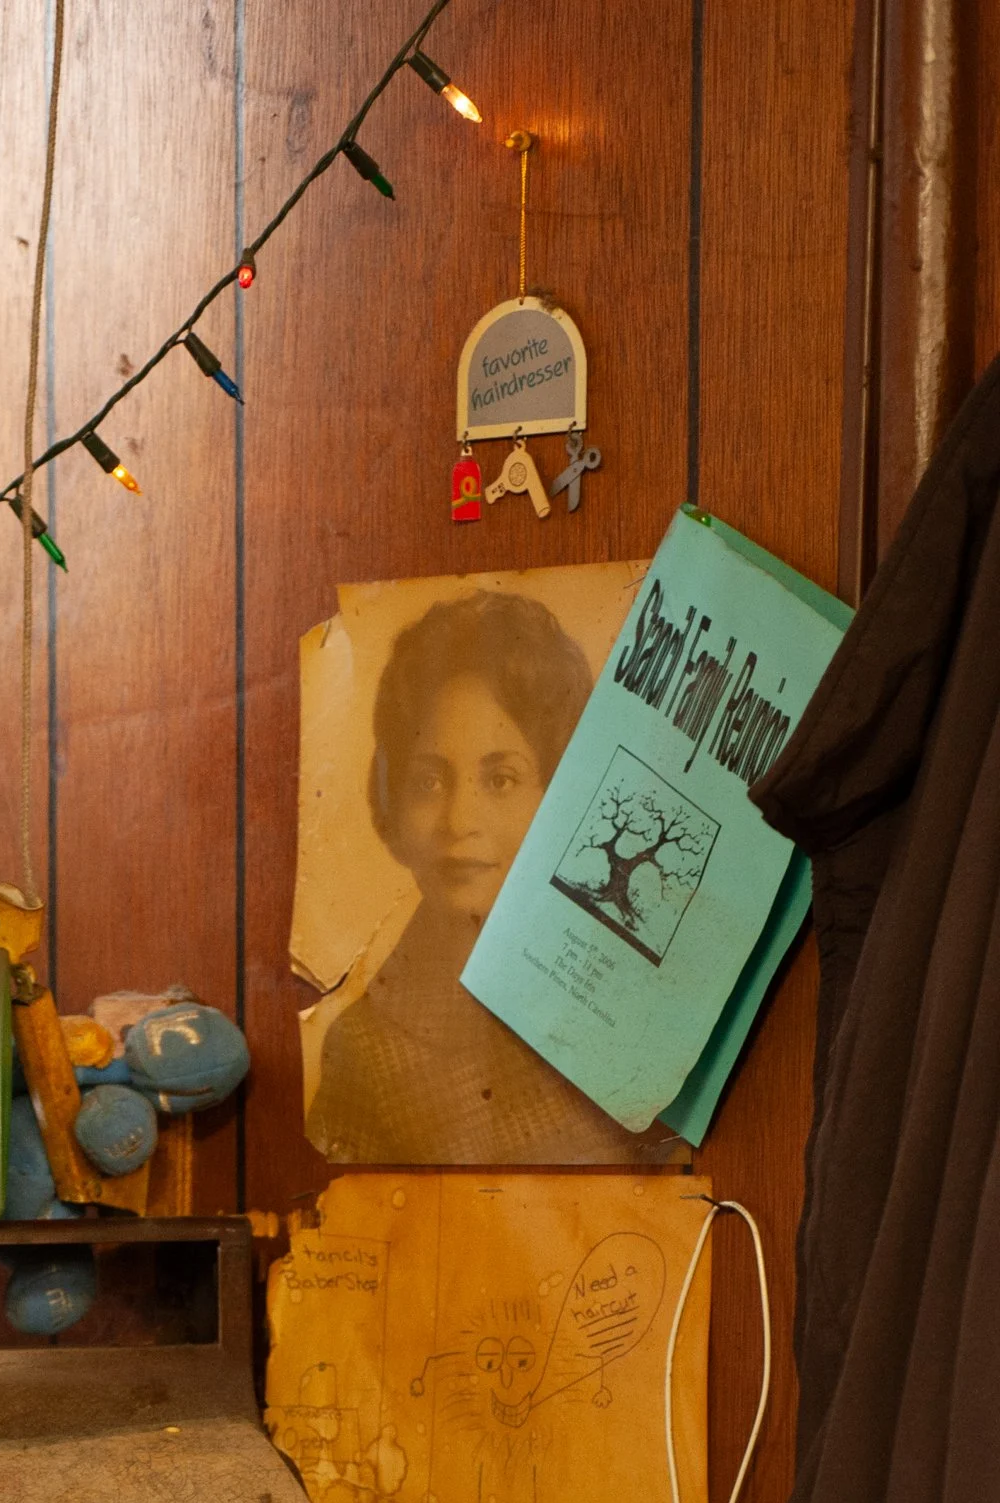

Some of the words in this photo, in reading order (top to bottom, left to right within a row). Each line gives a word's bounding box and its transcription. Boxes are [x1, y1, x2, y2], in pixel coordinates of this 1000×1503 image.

[482, 338, 548, 378] favorite
[471, 356, 572, 411] hairdresser
[575, 1264, 618, 1300] Need
[625, 1265, 639, 1277] a
[570, 1290, 637, 1323] haircut
